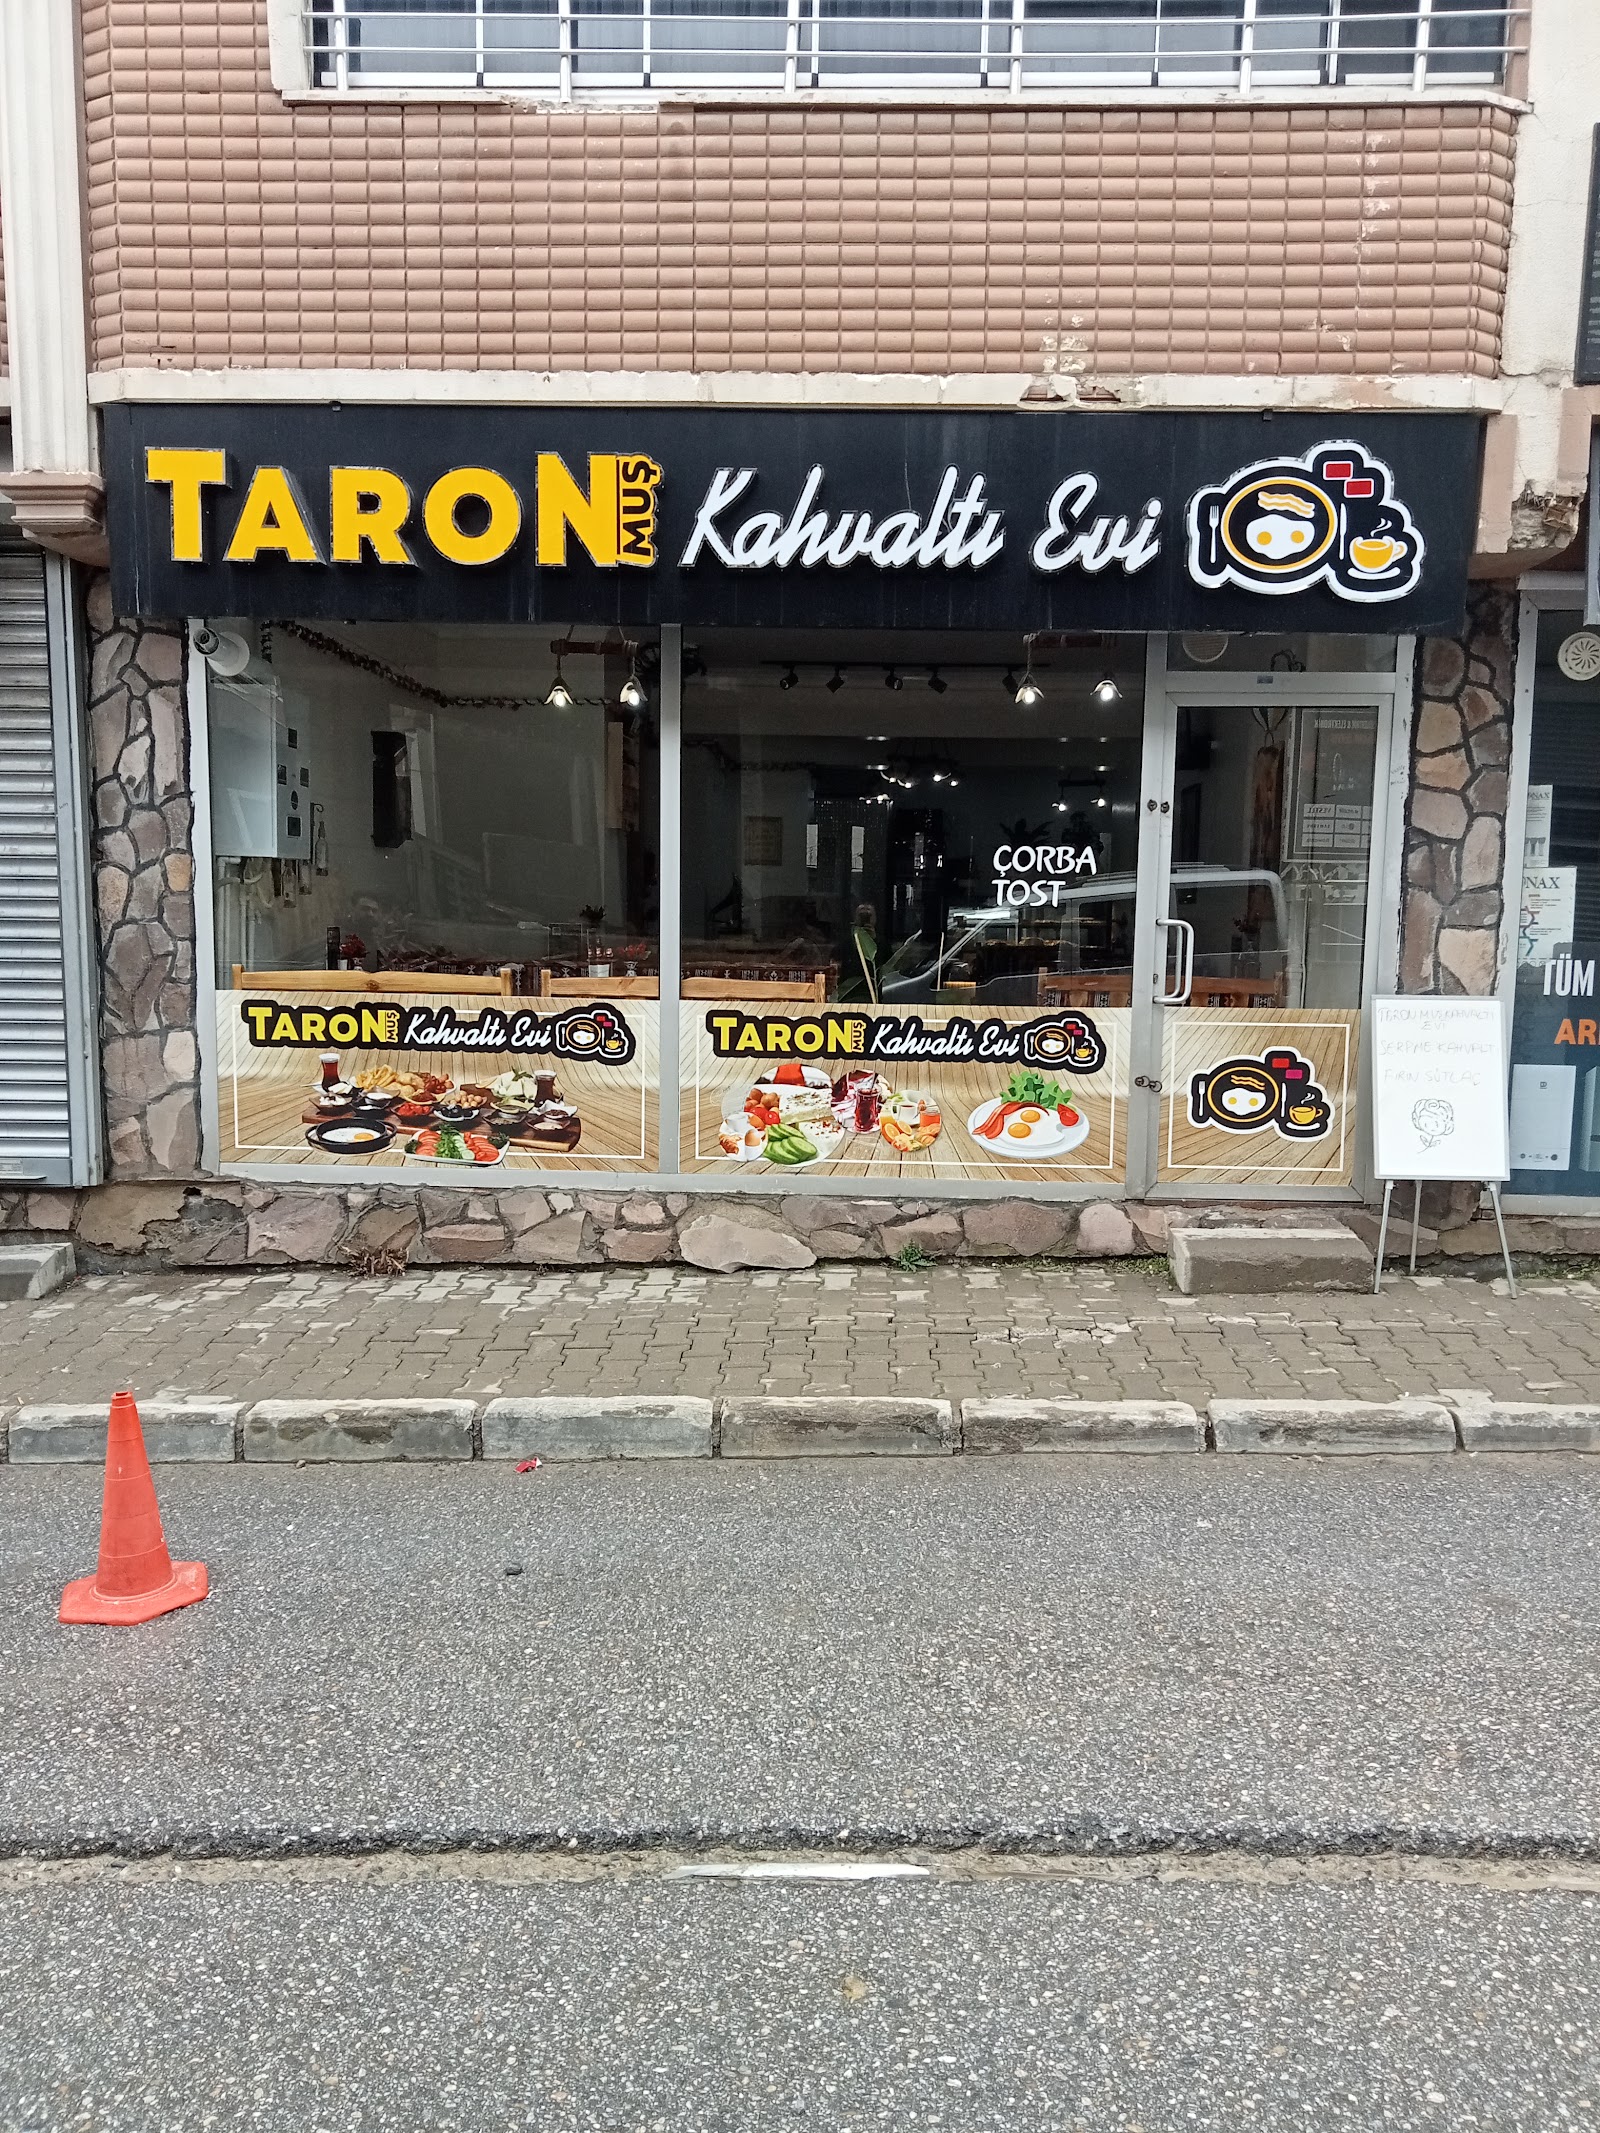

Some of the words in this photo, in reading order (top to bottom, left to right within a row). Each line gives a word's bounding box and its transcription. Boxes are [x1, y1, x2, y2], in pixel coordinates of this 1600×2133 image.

[145, 447, 618, 567] TARON
[621, 459, 662, 557] MUŞ
[678, 463, 1005, 568] Kahvaltı
[1030, 470, 1162, 574] Evi
[993, 845, 1097, 877] ÇORBA
[991, 879, 1066, 908] TOST
[1543, 953, 1596, 997] TÜM
[248, 1006, 387, 1043] TARON
[387, 1011, 398, 1043] MUŞ
[404, 1013, 506, 1047] Kahvaltı
[510, 1017, 551, 1048] Evi
[712, 1017, 851, 1053] TARON
[852, 1020, 866, 1053] MUŞ
[870, 1026, 974, 1057] Kahvaltı
[979, 1027, 1020, 1058] Evi
[1554, 1018, 1600, 1046] AR
